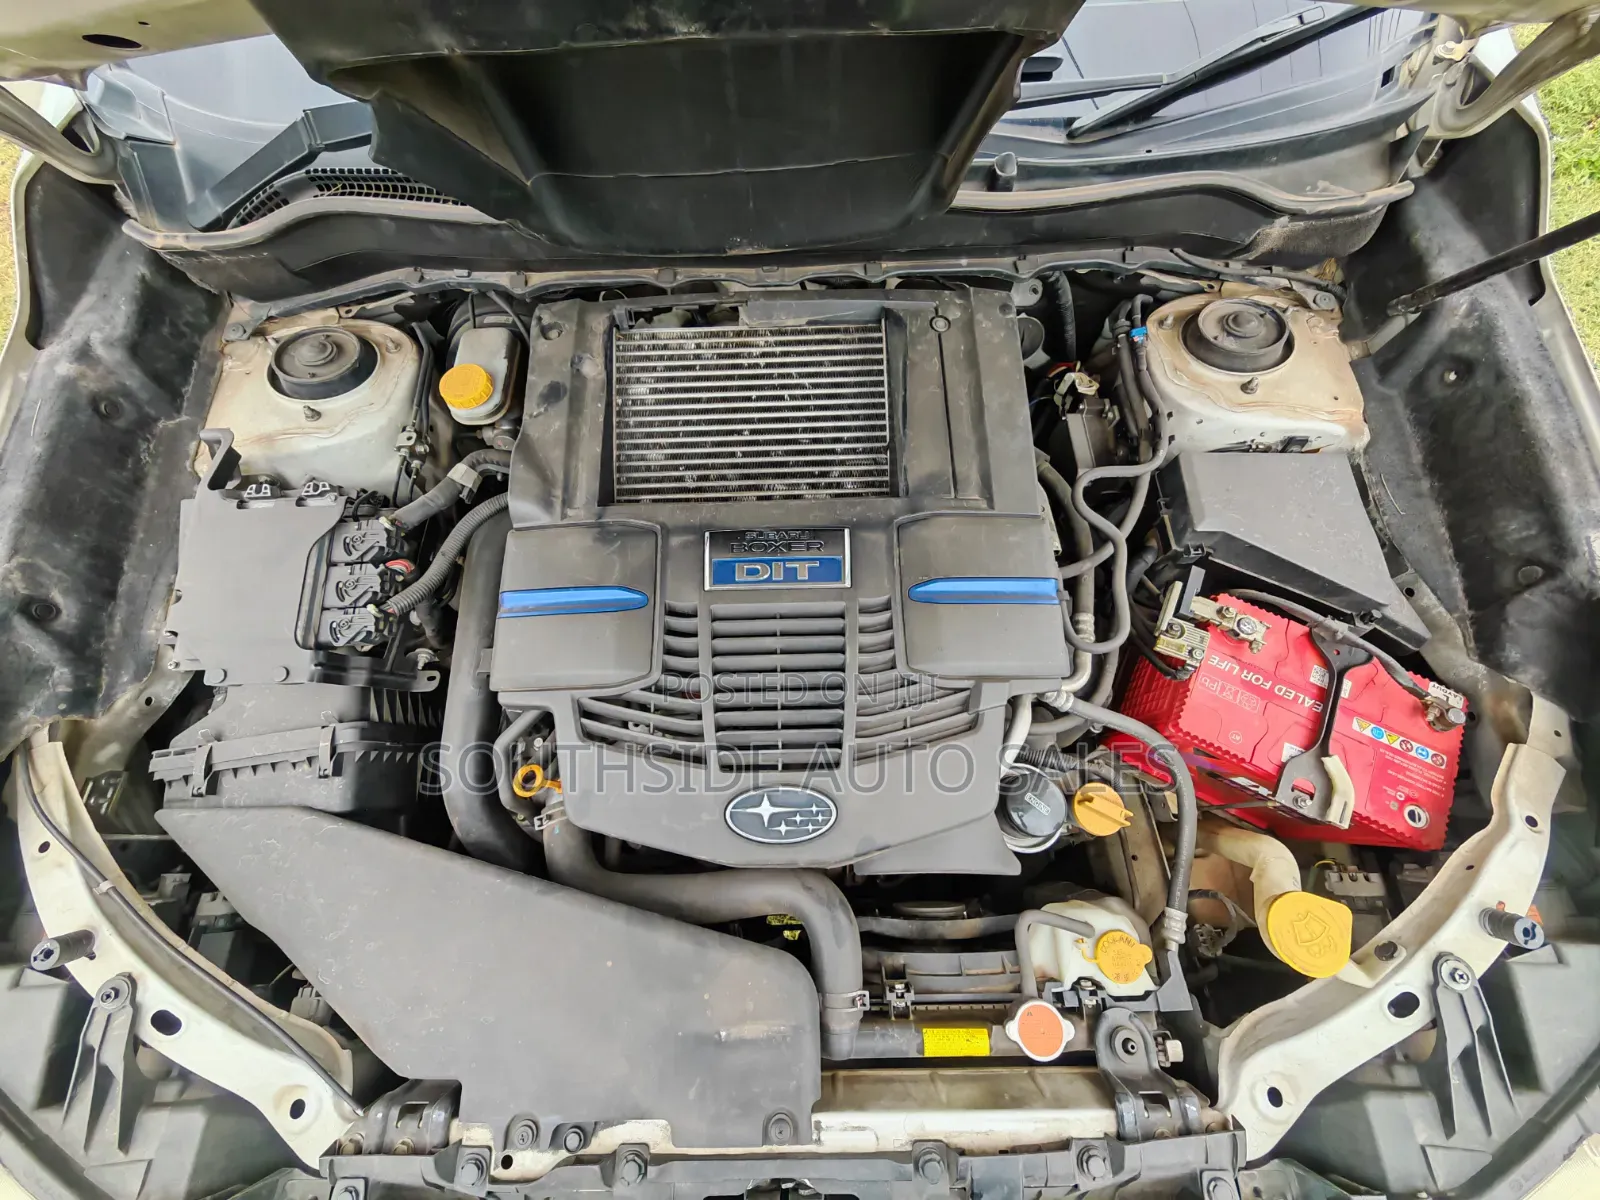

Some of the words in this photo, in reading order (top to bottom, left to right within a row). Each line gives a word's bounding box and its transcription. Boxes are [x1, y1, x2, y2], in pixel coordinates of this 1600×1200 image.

[744, 531, 811, 540] SUBARU
[731, 541, 825, 553] BOXER
[735, 561, 820, 582] DIT
[1207, 654, 1240, 675] LIFE
[1241, 669, 1273, 690] FOR
[1274, 684, 1324, 713] EALED
